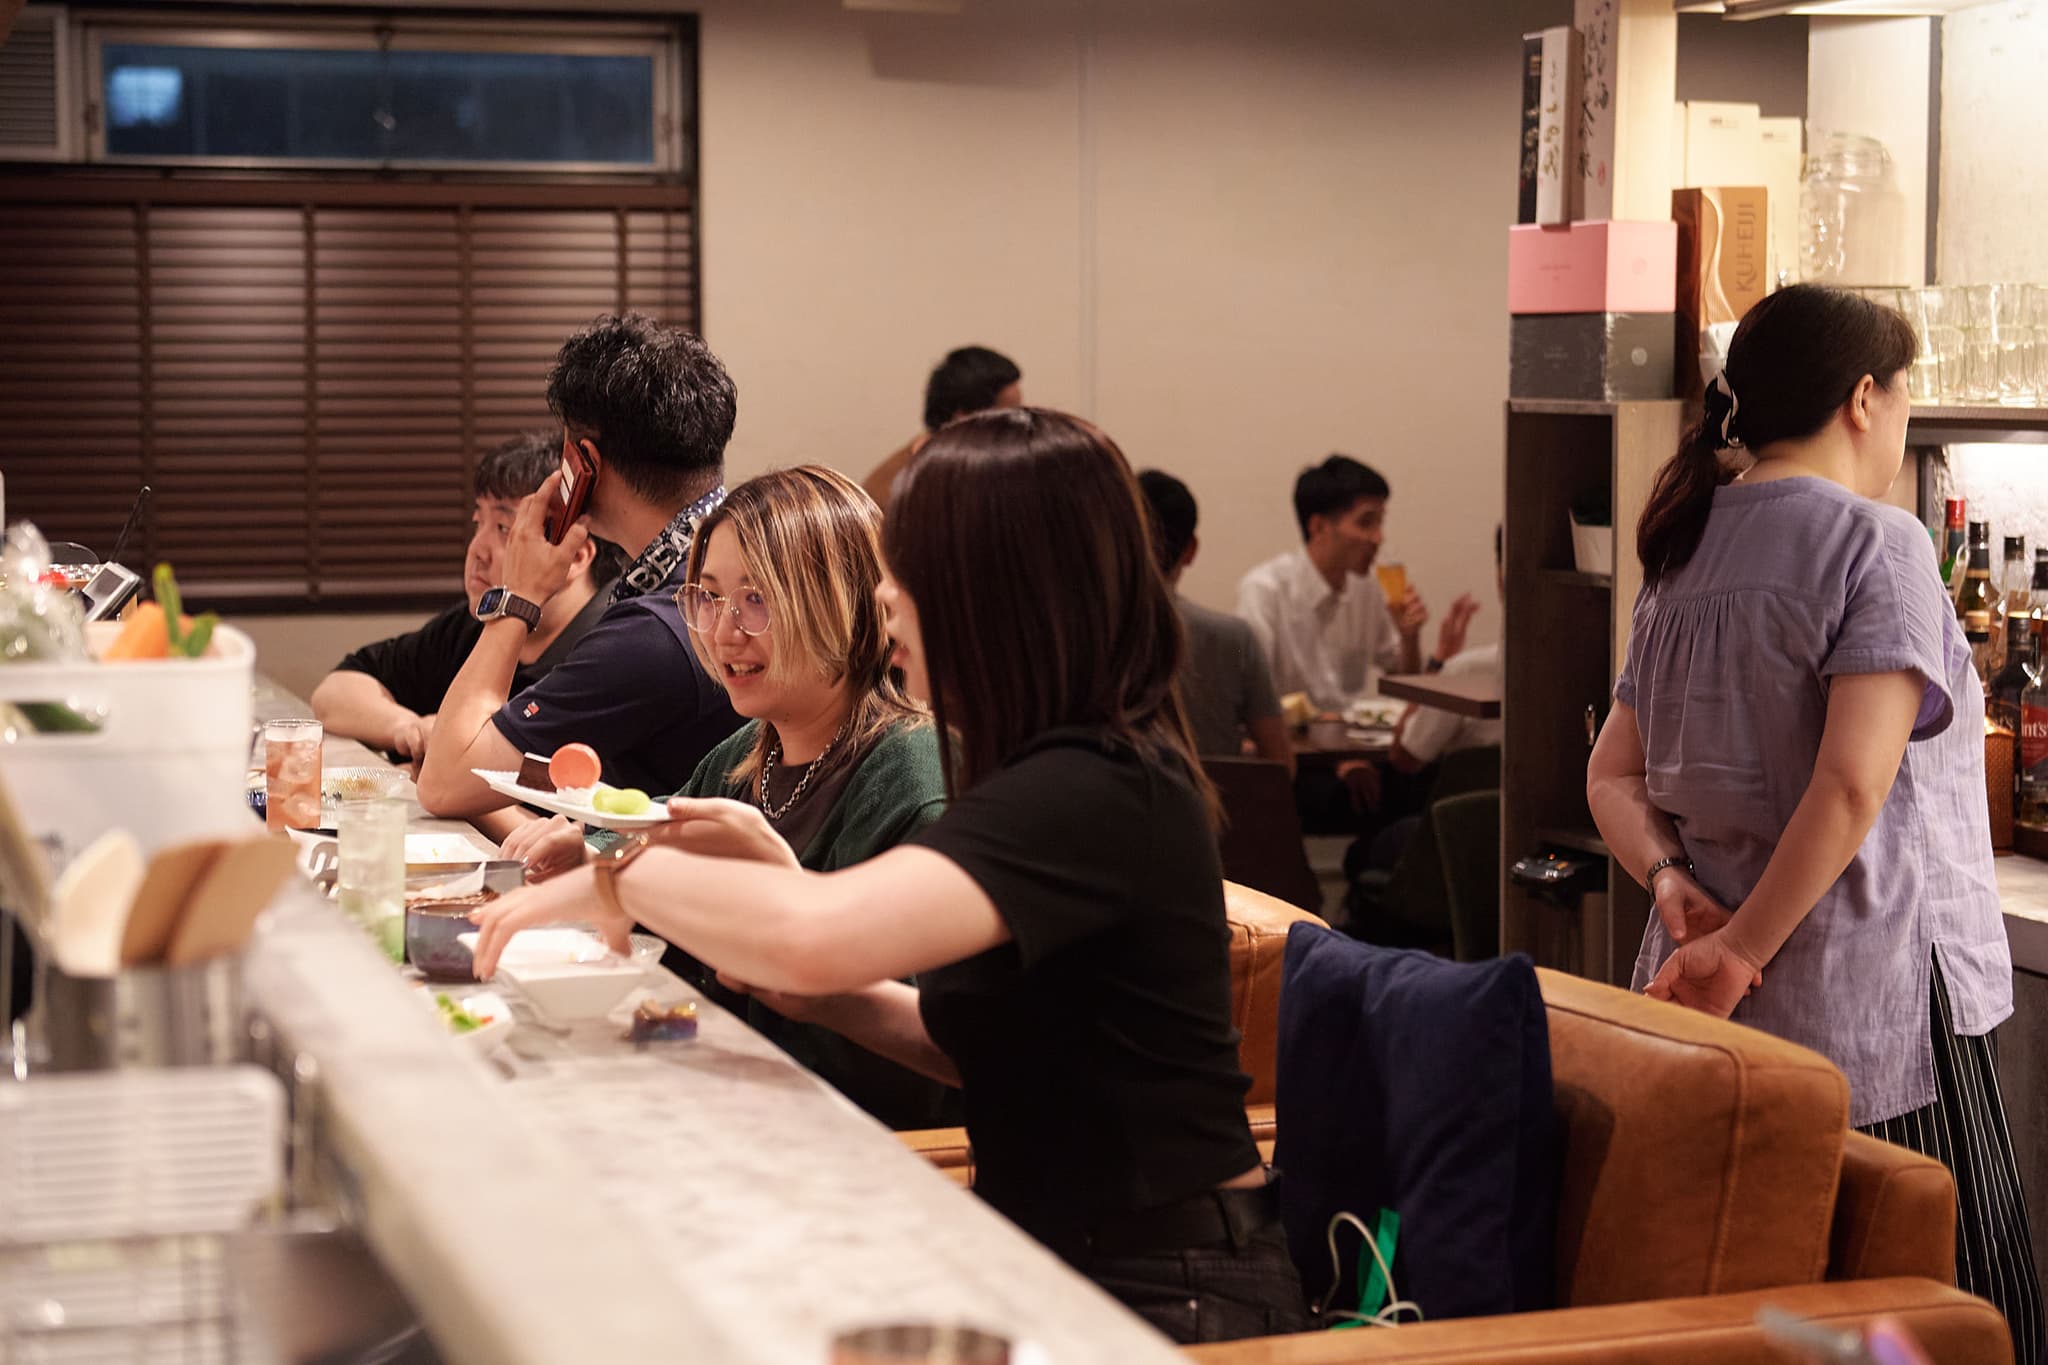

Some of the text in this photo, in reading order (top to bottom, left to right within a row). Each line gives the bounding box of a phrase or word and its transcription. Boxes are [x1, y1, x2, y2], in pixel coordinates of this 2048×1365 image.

[1736, 203, 1757, 292] KUHEIJI
[626, 517, 700, 593] BEA
[2021, 722, 2048, 738] nt's
